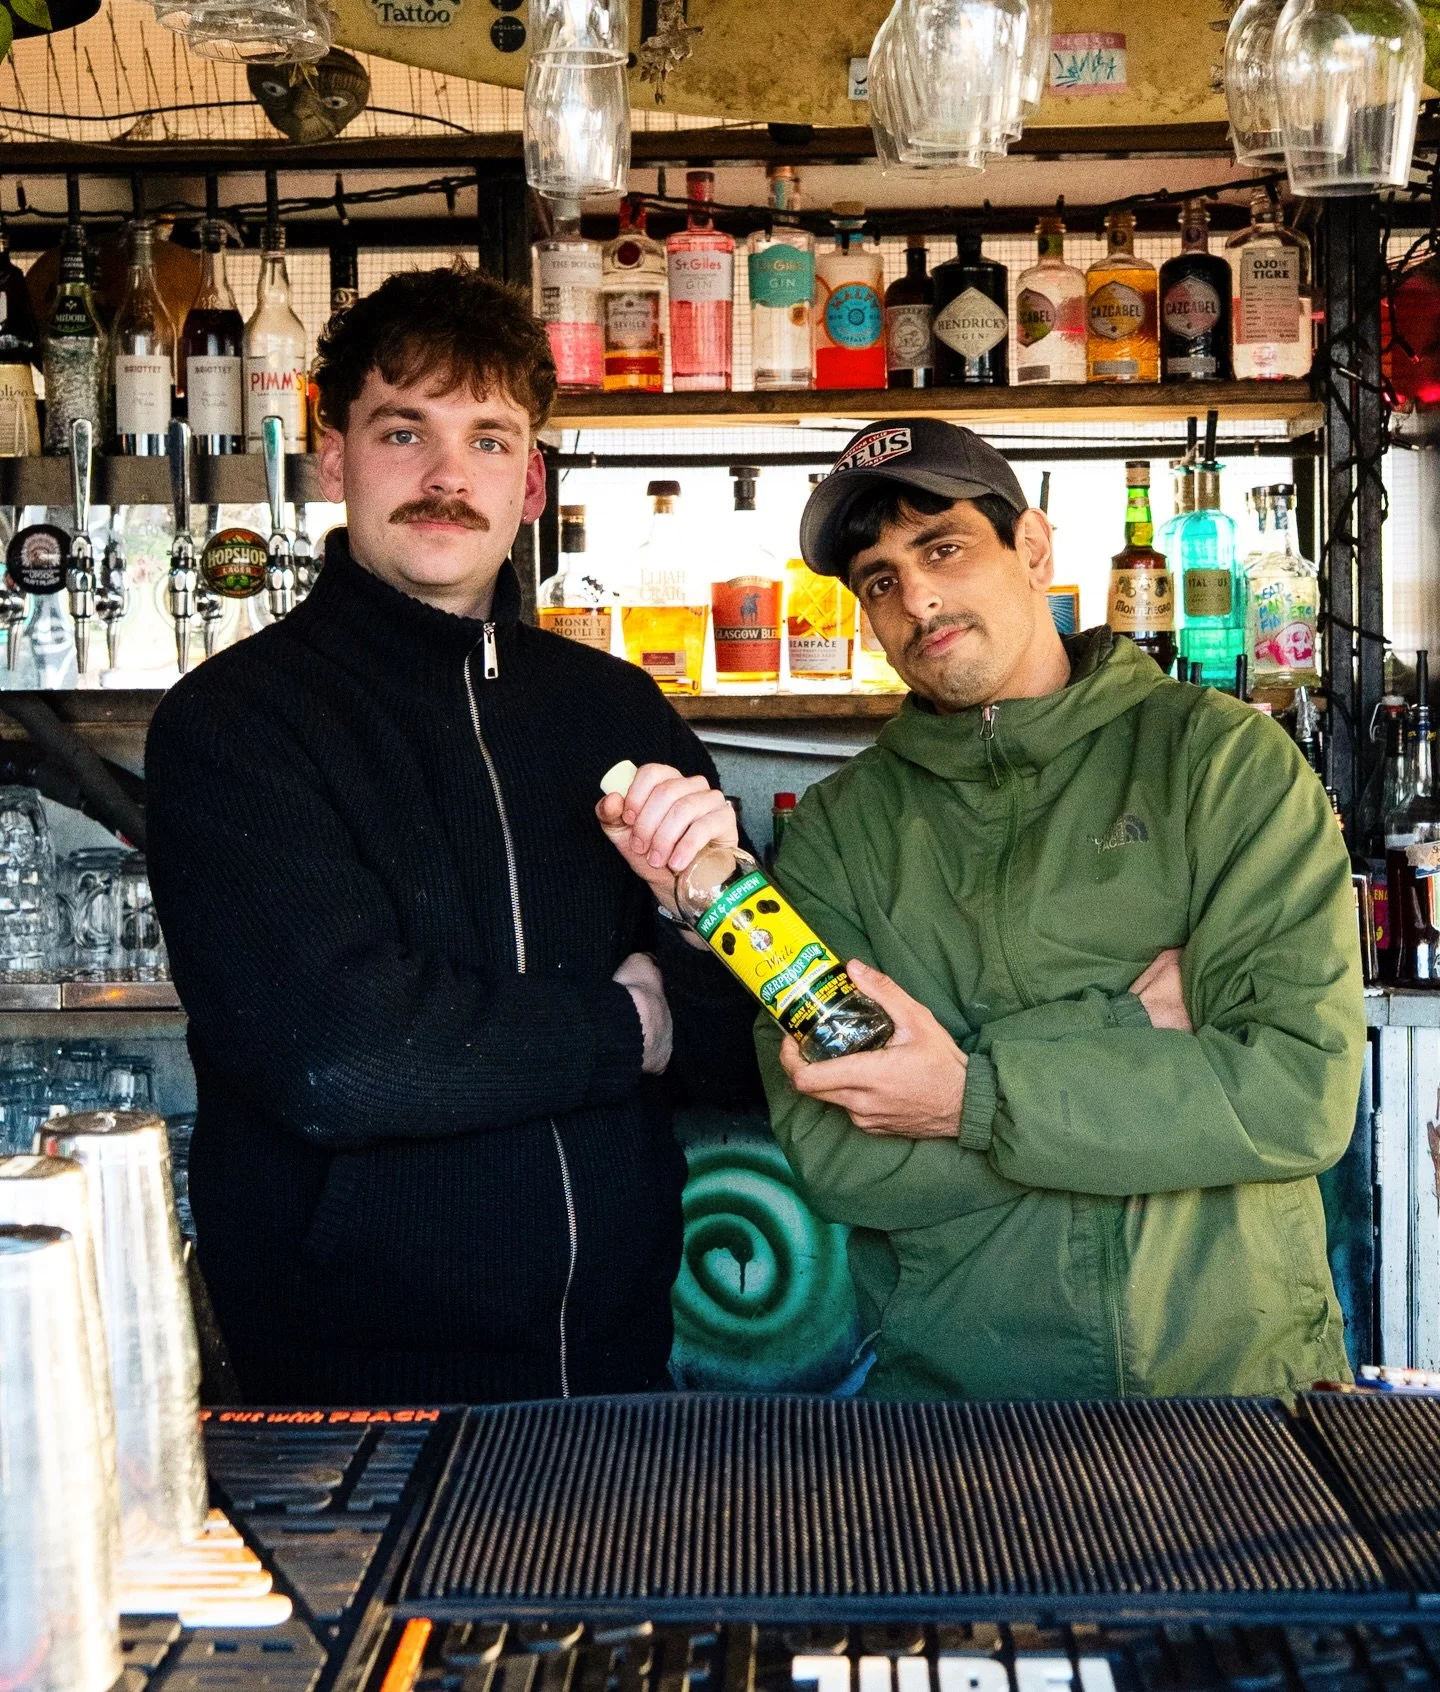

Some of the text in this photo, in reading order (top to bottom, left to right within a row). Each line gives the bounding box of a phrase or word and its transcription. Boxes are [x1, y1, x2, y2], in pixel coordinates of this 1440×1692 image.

[378, 3, 450, 23] Tattoo
[1253, 260, 1277, 269] OJO
[1253, 270, 1290, 279] TIGRE
[686, 281, 712, 290] GIN
[769, 278, 796, 288] GIN
[1091, 304, 1141, 318] CAZCABEL
[1166, 301, 1216, 315] CAZCABEL
[56, 314, 87, 322] MIDORI
[250, 368, 303, 391] PIMM'S
[207, 547, 267, 568] HOPSHOP
[640, 568, 685, 584] ELIJAH
[640, 586, 685, 602] CRAIG
[715, 628, 759, 639] GLASGOW
[789, 640, 836, 648] BEARFACE
[701, 876, 760, 932] WRAY & NEPHEW
[755, 945, 794, 977] White
[762, 945, 822, 1000] OVERPROOF RUM
[790, 1006, 806, 1024] WRAY
[812, 978, 839, 1000] EPHEW
[328, 1408, 440, 1423] PEACH
